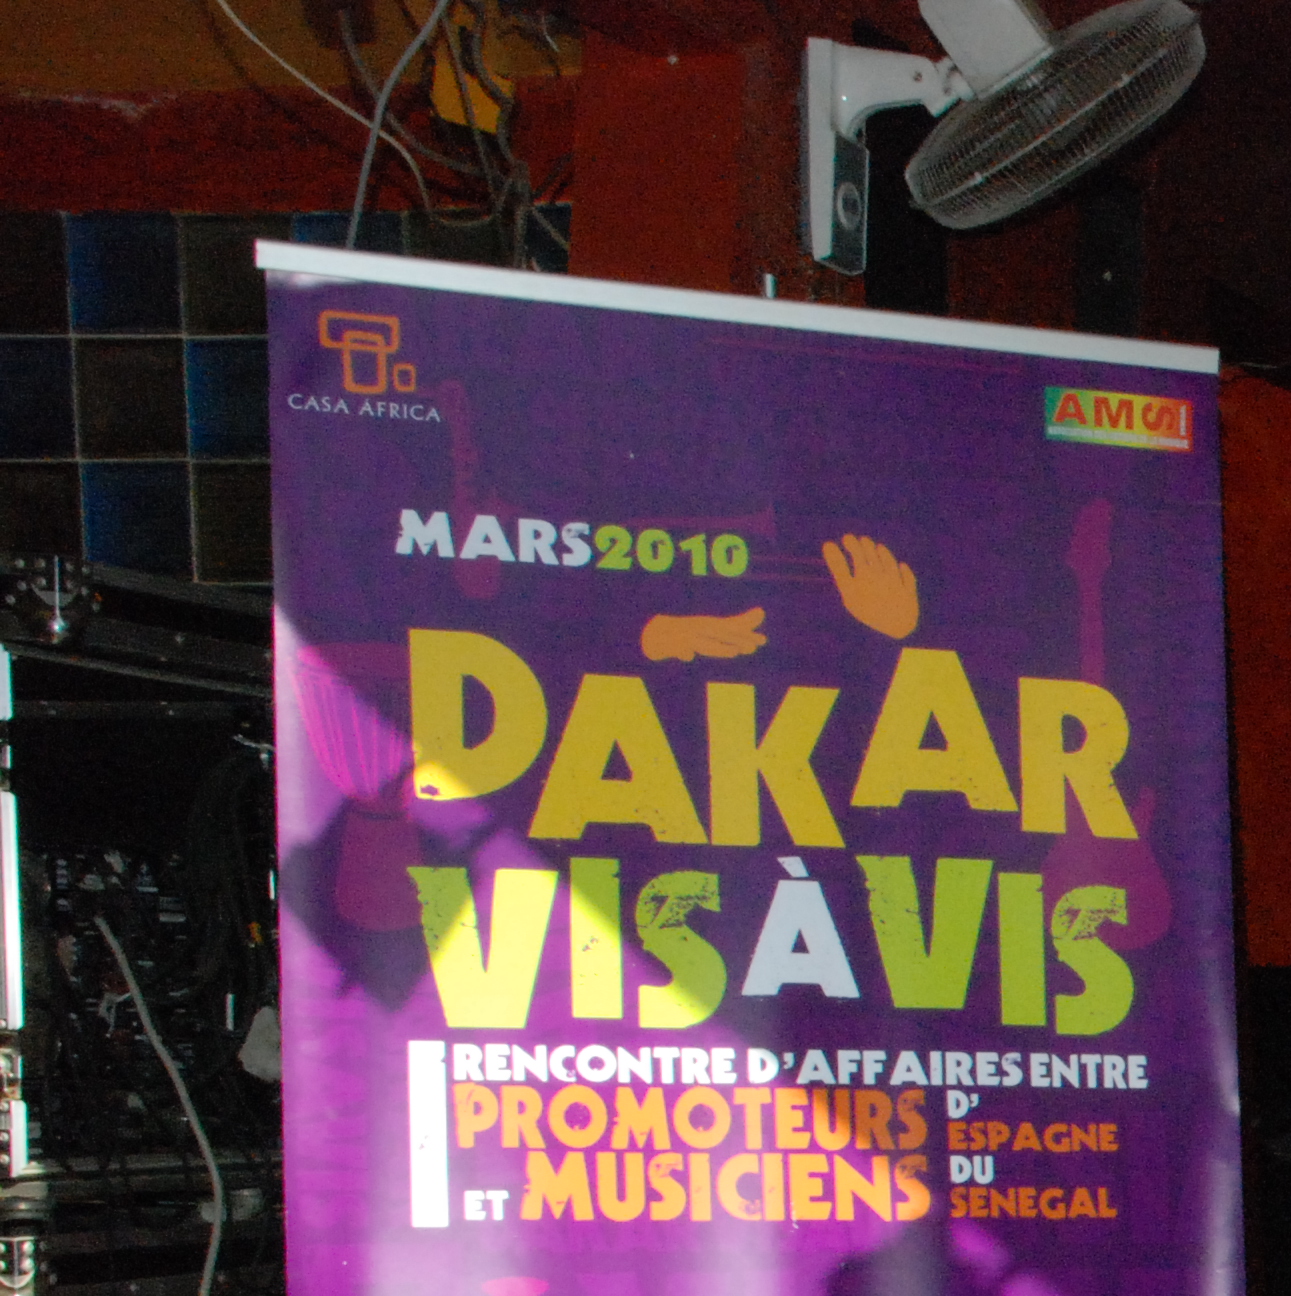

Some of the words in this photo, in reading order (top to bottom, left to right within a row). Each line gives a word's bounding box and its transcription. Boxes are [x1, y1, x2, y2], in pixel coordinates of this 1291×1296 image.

[287, 393, 349, 415] CASA
[409, 628, 1139, 848] DAKAR
[453, 1043, 737, 1084] RENCONTRE
[453, 1082, 927, 1152] PROMOTEURS
[947, 1090, 980, 1119] D'
[948, 1121, 1119, 1152] ESPAGNE
[463, 1190, 509, 1221] ET
[519, 1151, 932, 1222] MUSICIENS
[949, 1155, 995, 1185] DU
[948, 1187, 1117, 1219] SENEGAL
